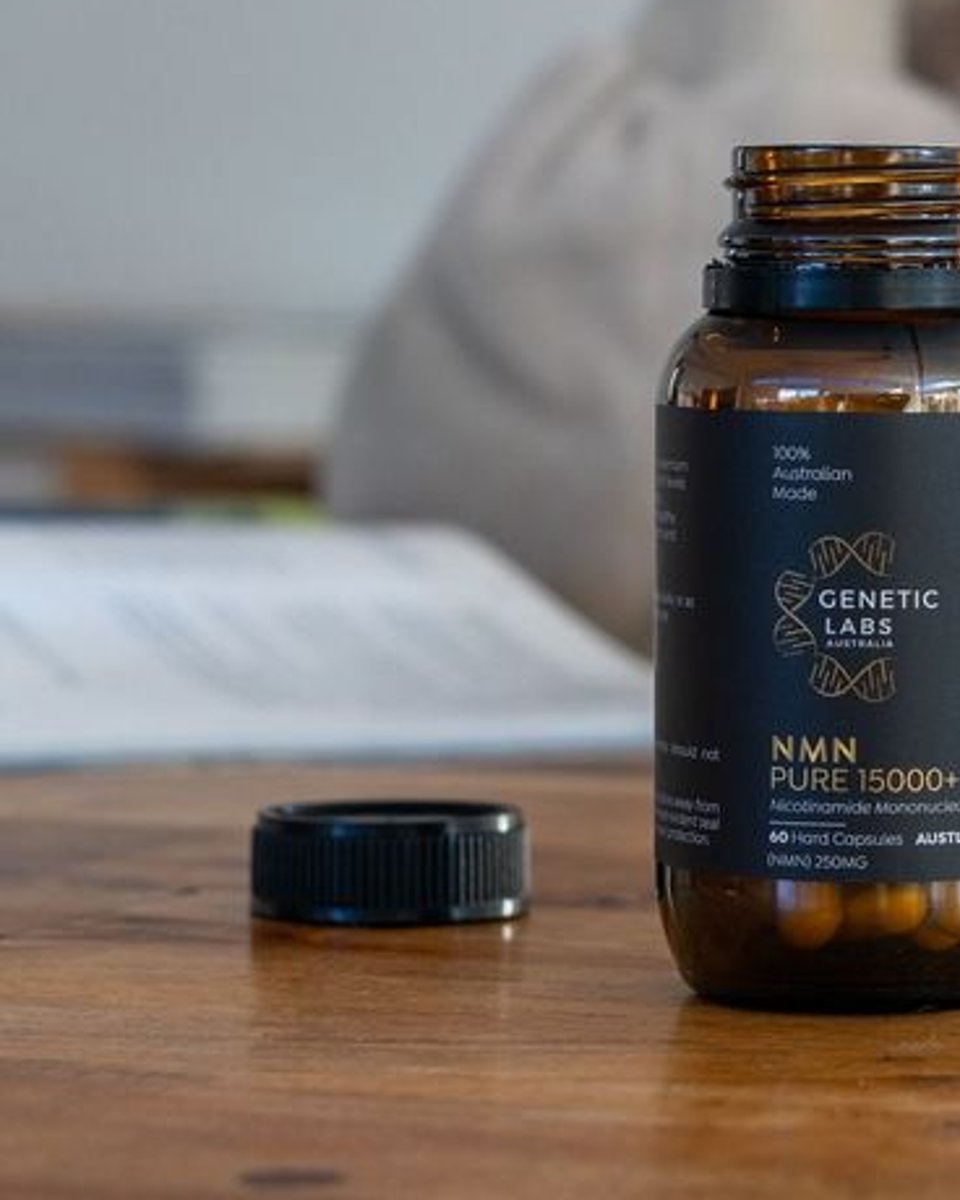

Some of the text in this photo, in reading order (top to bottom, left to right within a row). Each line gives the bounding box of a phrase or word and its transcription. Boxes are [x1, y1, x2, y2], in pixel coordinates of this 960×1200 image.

[772, 445, 811, 461] 100%
[772, 465, 853, 482] Australian
[772, 486, 818, 501] Made
[818, 589, 940, 609] GENETIC
[825, 617, 893, 635] LABS
[826, 639, 894, 648] AUSTRALIA
[771, 735, 857, 763] NMN
[770, 766, 960, 792] PURE 15000+
[770, 798, 872, 814] Nicotinamide
[769, 831, 789, 843] 60
[792, 832, 830, 845] Hard
[832, 832, 904, 847] Capsules
[766, 852, 868, 869] (NMN) 250MG
